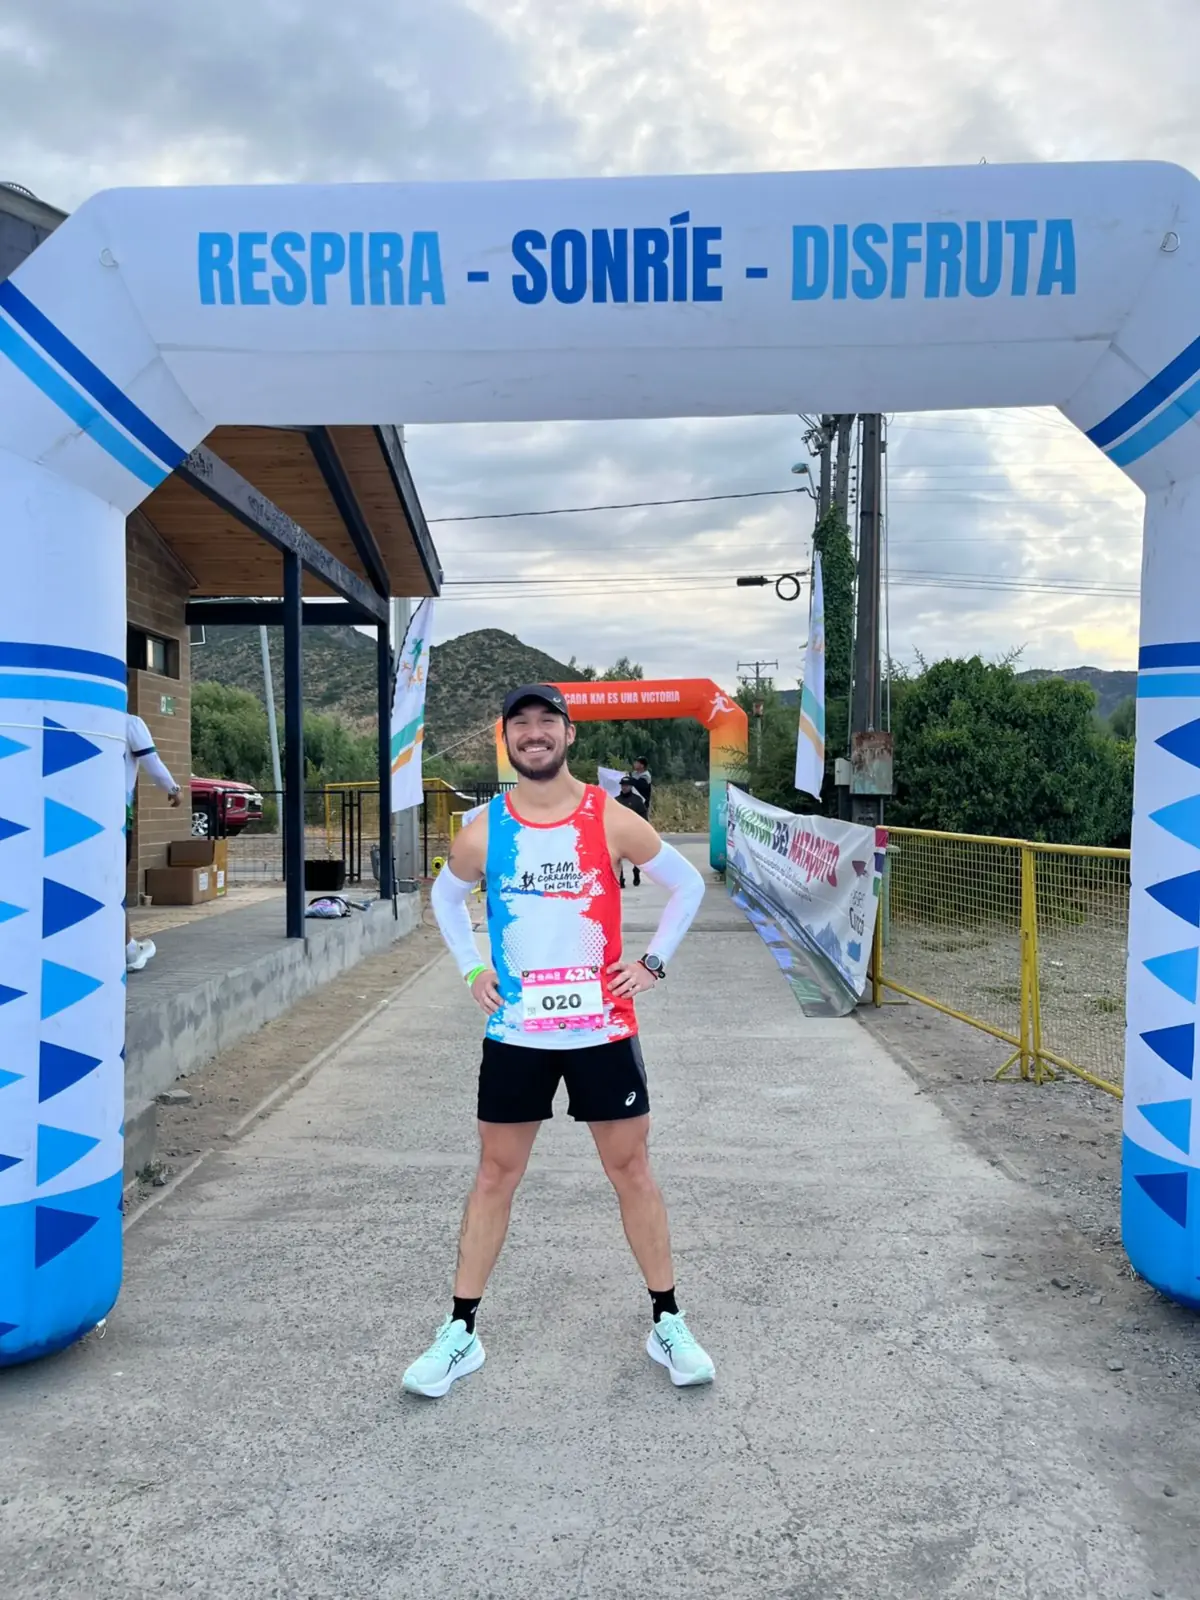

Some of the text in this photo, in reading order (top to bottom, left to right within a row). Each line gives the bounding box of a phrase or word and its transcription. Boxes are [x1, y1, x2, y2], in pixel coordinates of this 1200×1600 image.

[198, 210, 1077, 305] RESPIRA - SONRÍE - DISFRUTA
[563, 690, 681, 705] CADA KM ES UNA VICTORIA
[540, 861, 574, 875] TEAM
[537, 872, 583, 883] CORRAMOS
[544, 880, 580, 891] EN CHILE
[564, 967, 597, 982] 42K
[541, 993, 582, 1011] 020
